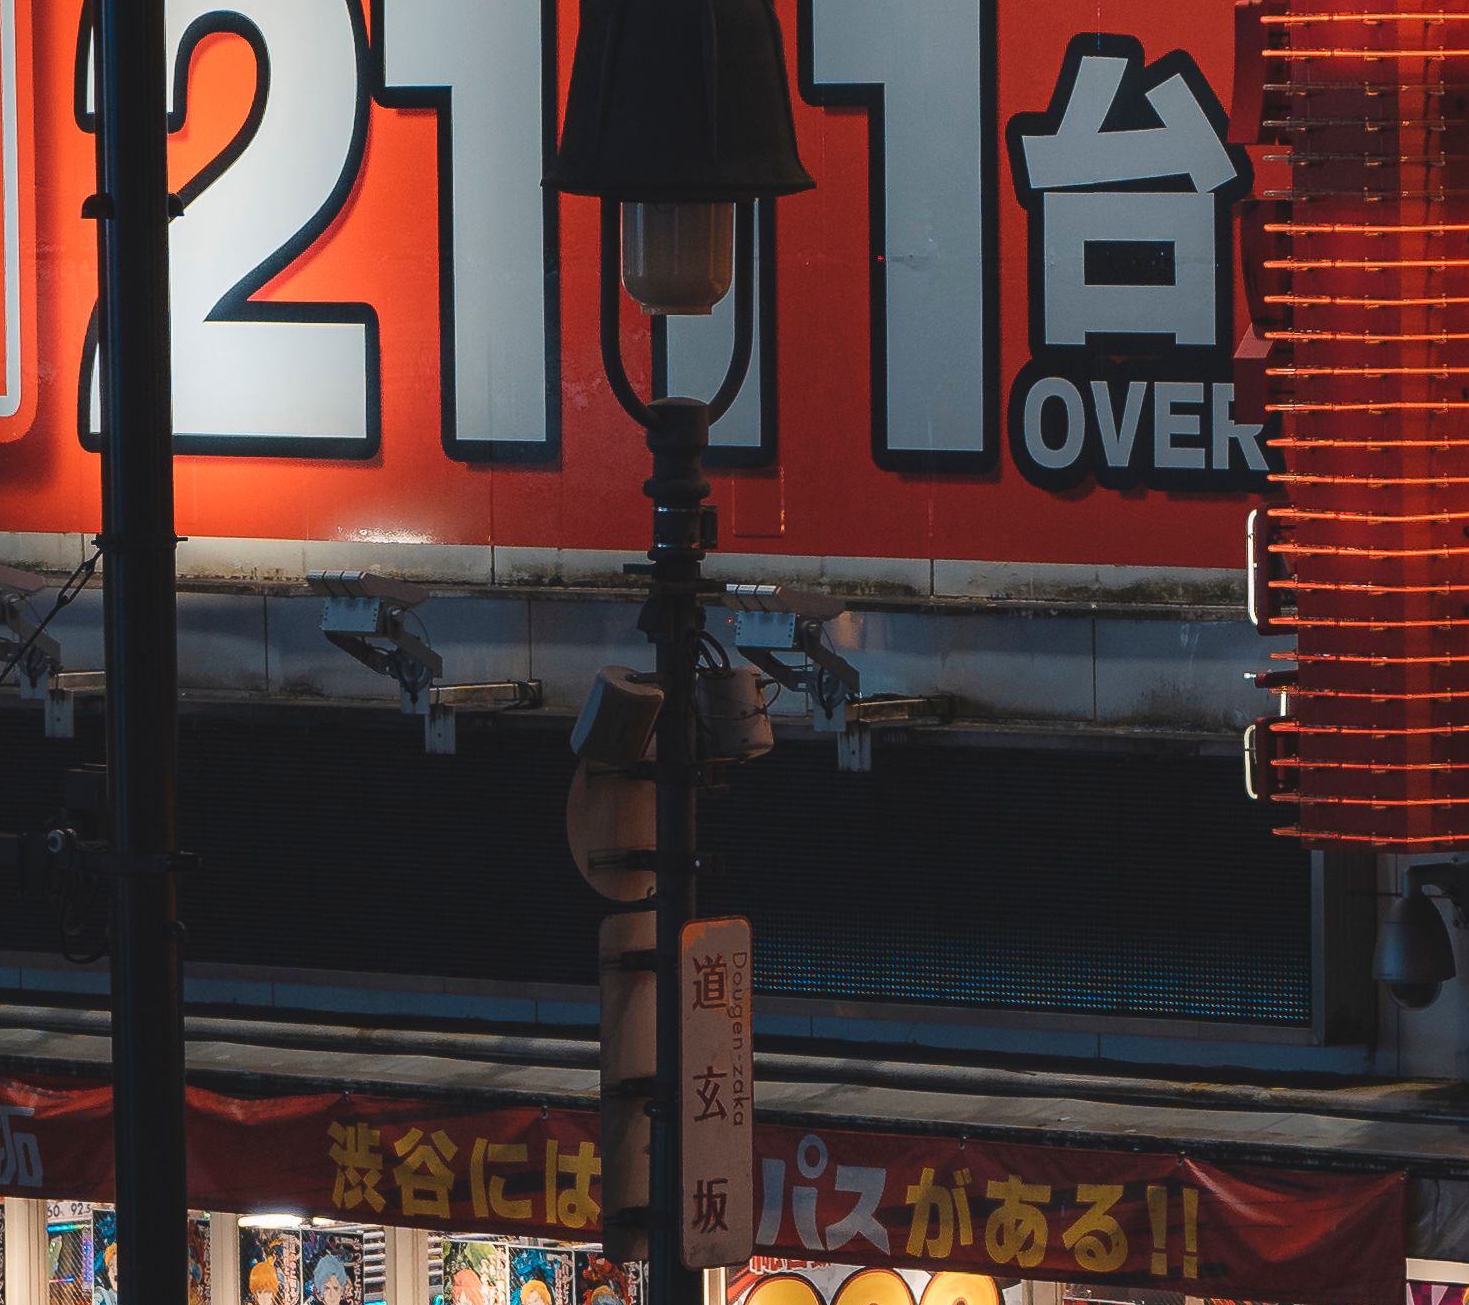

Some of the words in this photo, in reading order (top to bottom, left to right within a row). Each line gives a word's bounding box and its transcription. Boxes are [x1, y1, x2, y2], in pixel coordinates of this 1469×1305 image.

[1023, 374, 1269, 469] OVER
[691, 952, 729, 1235] 道玄坂
[727, 951, 751, 1128] Dougen-zaka
